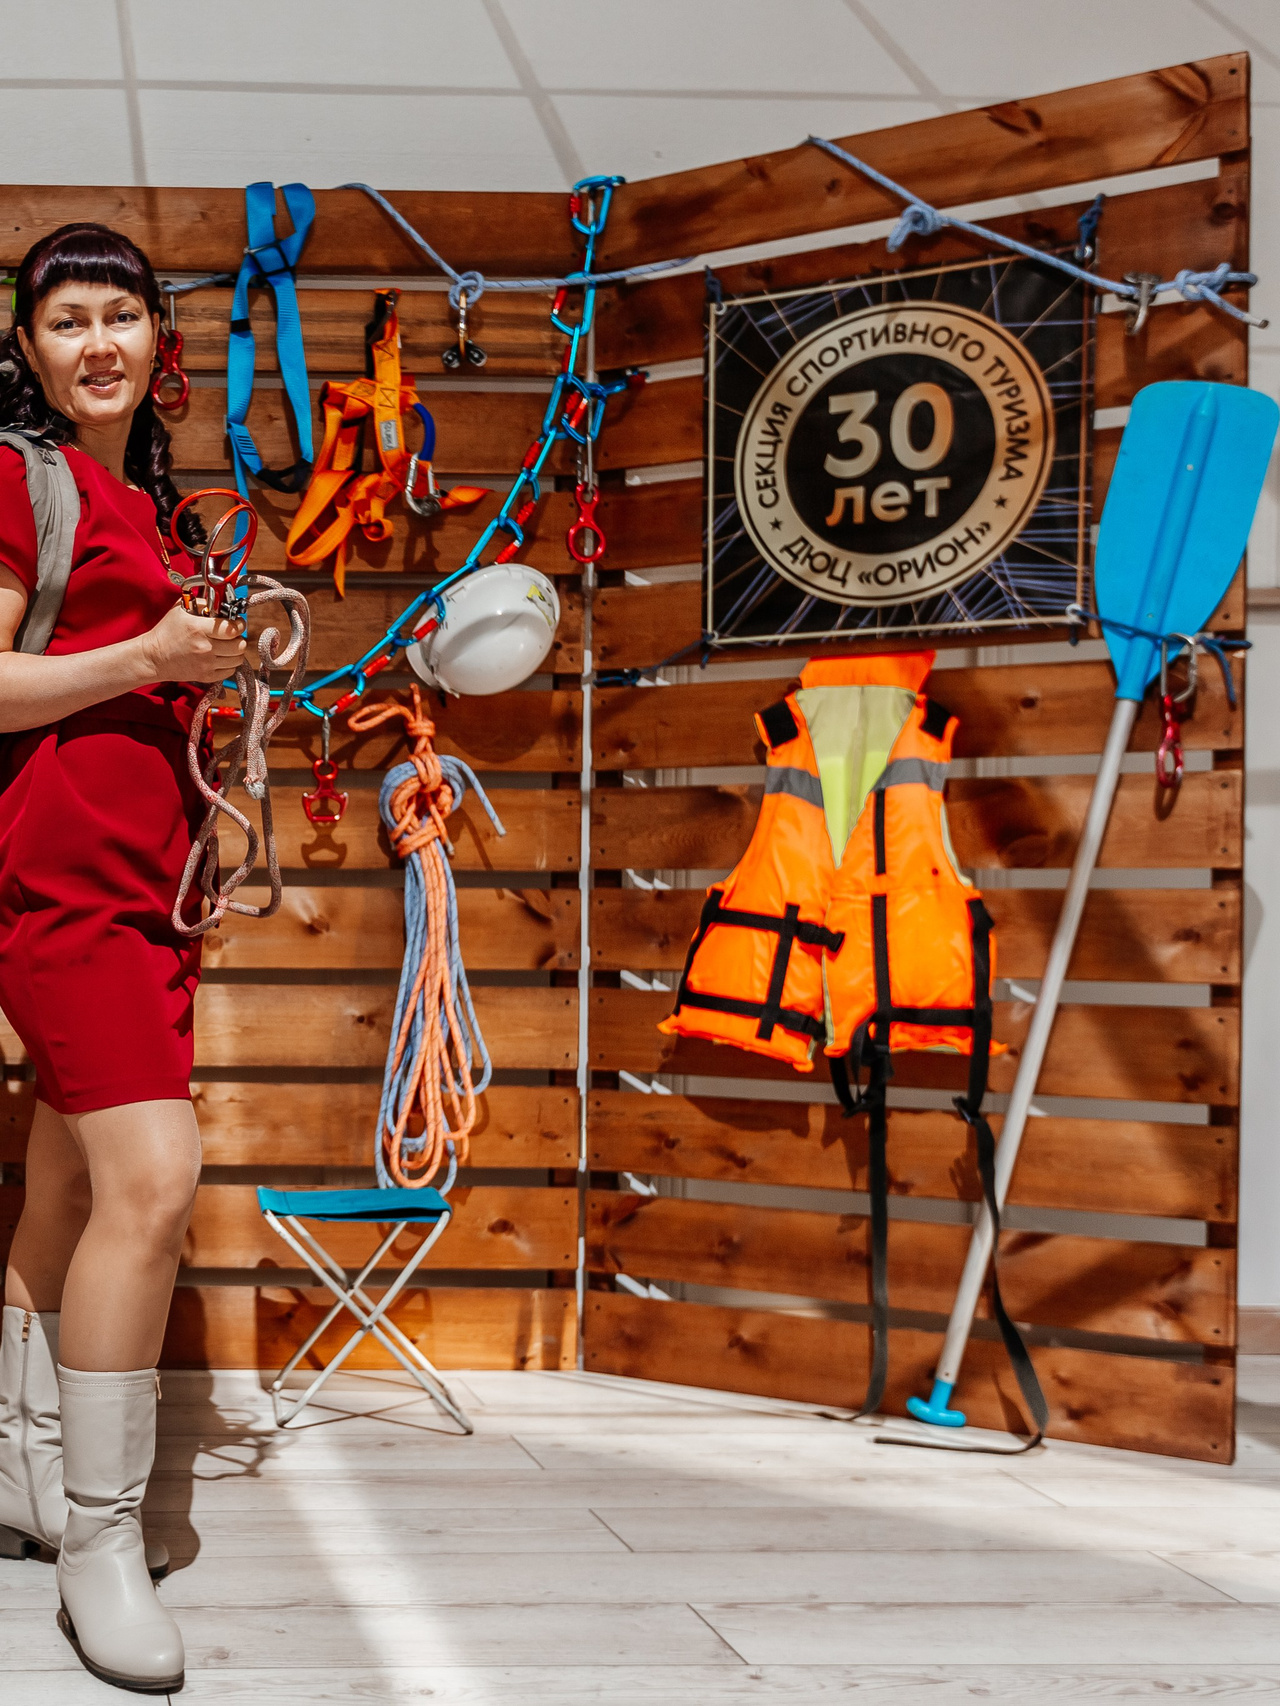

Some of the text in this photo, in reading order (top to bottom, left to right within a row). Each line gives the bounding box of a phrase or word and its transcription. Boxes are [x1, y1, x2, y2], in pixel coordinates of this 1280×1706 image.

[753, 321, 1031, 509] СЕКЦИЯ СПОРТИВНОГО ТУРИЗМА
[823, 381, 955, 480] 30
[825, 475, 952, 527] лет
[779, 520, 992, 588] ДЮЦ «ОРИОН»
